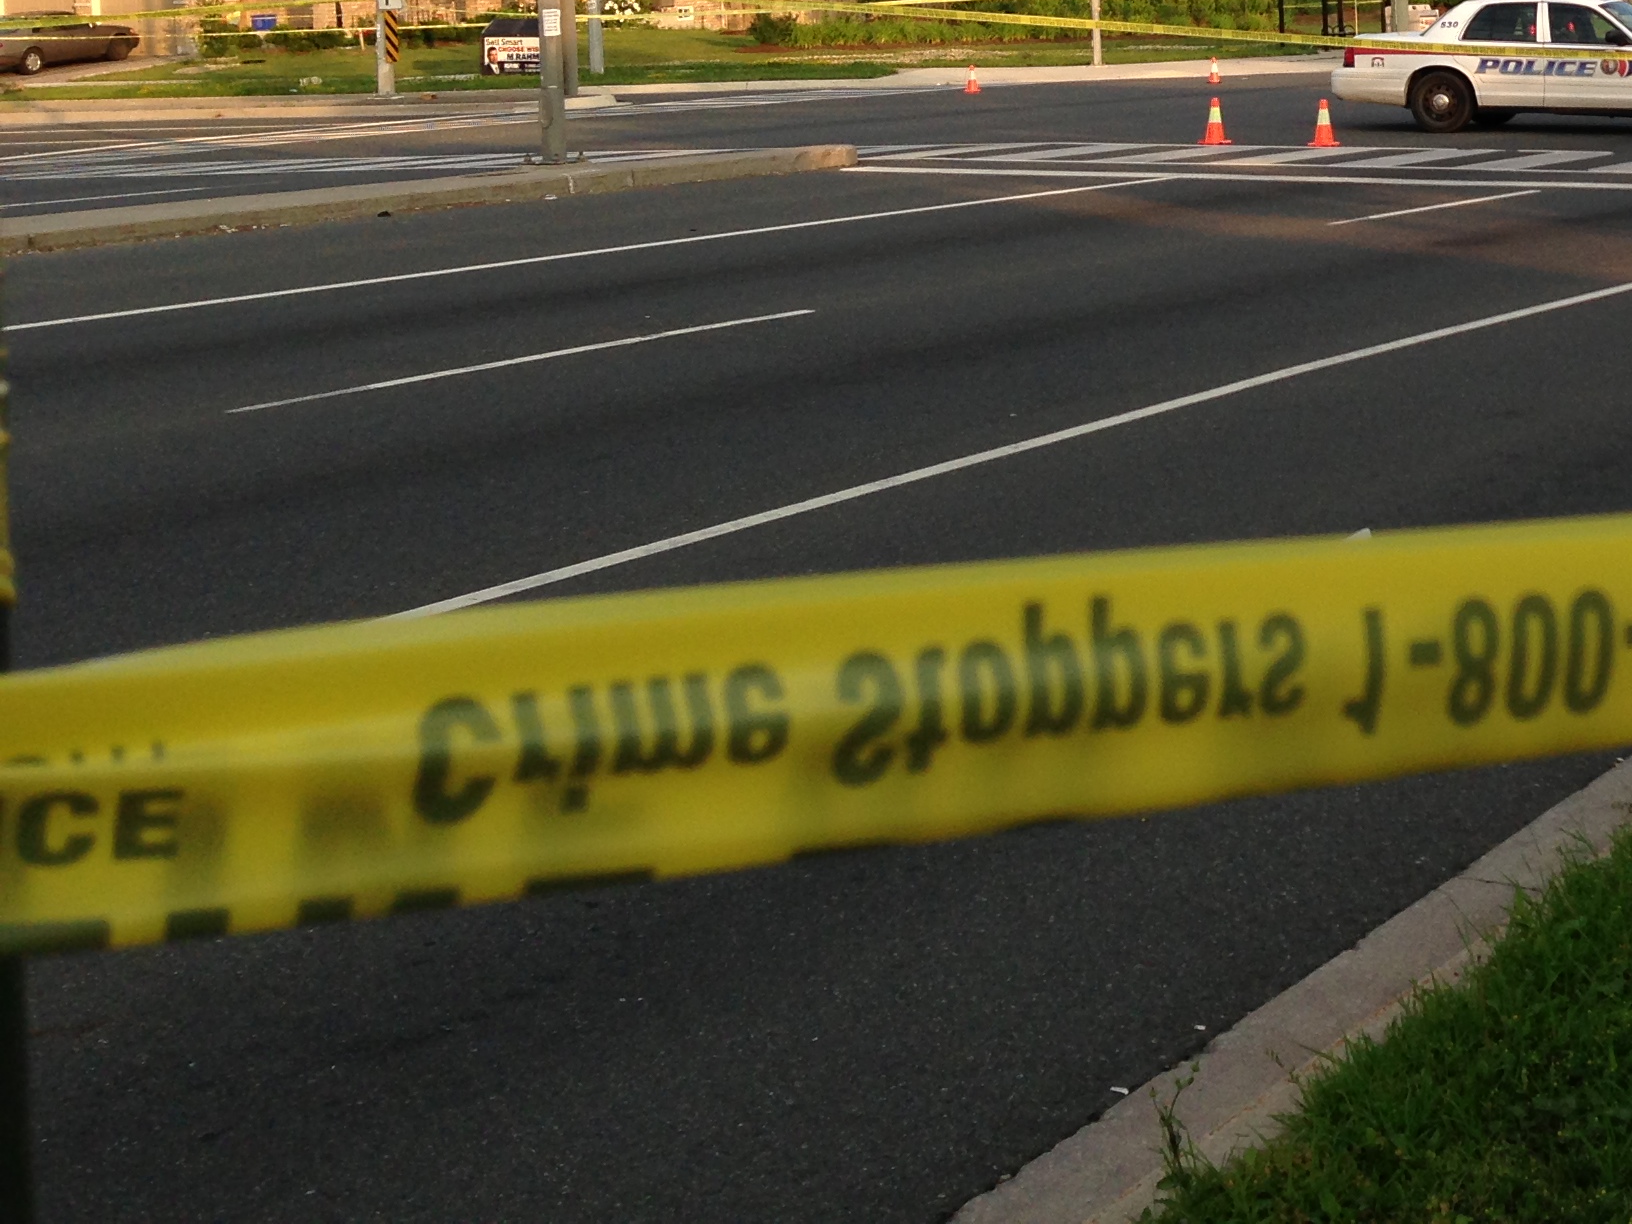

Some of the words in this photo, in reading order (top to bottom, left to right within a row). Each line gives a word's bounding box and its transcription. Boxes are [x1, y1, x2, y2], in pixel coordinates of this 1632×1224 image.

[501, 38, 523, 46] Smart
[506, 53, 514, 61] M
[1475, 57, 1598, 77] POLICE
